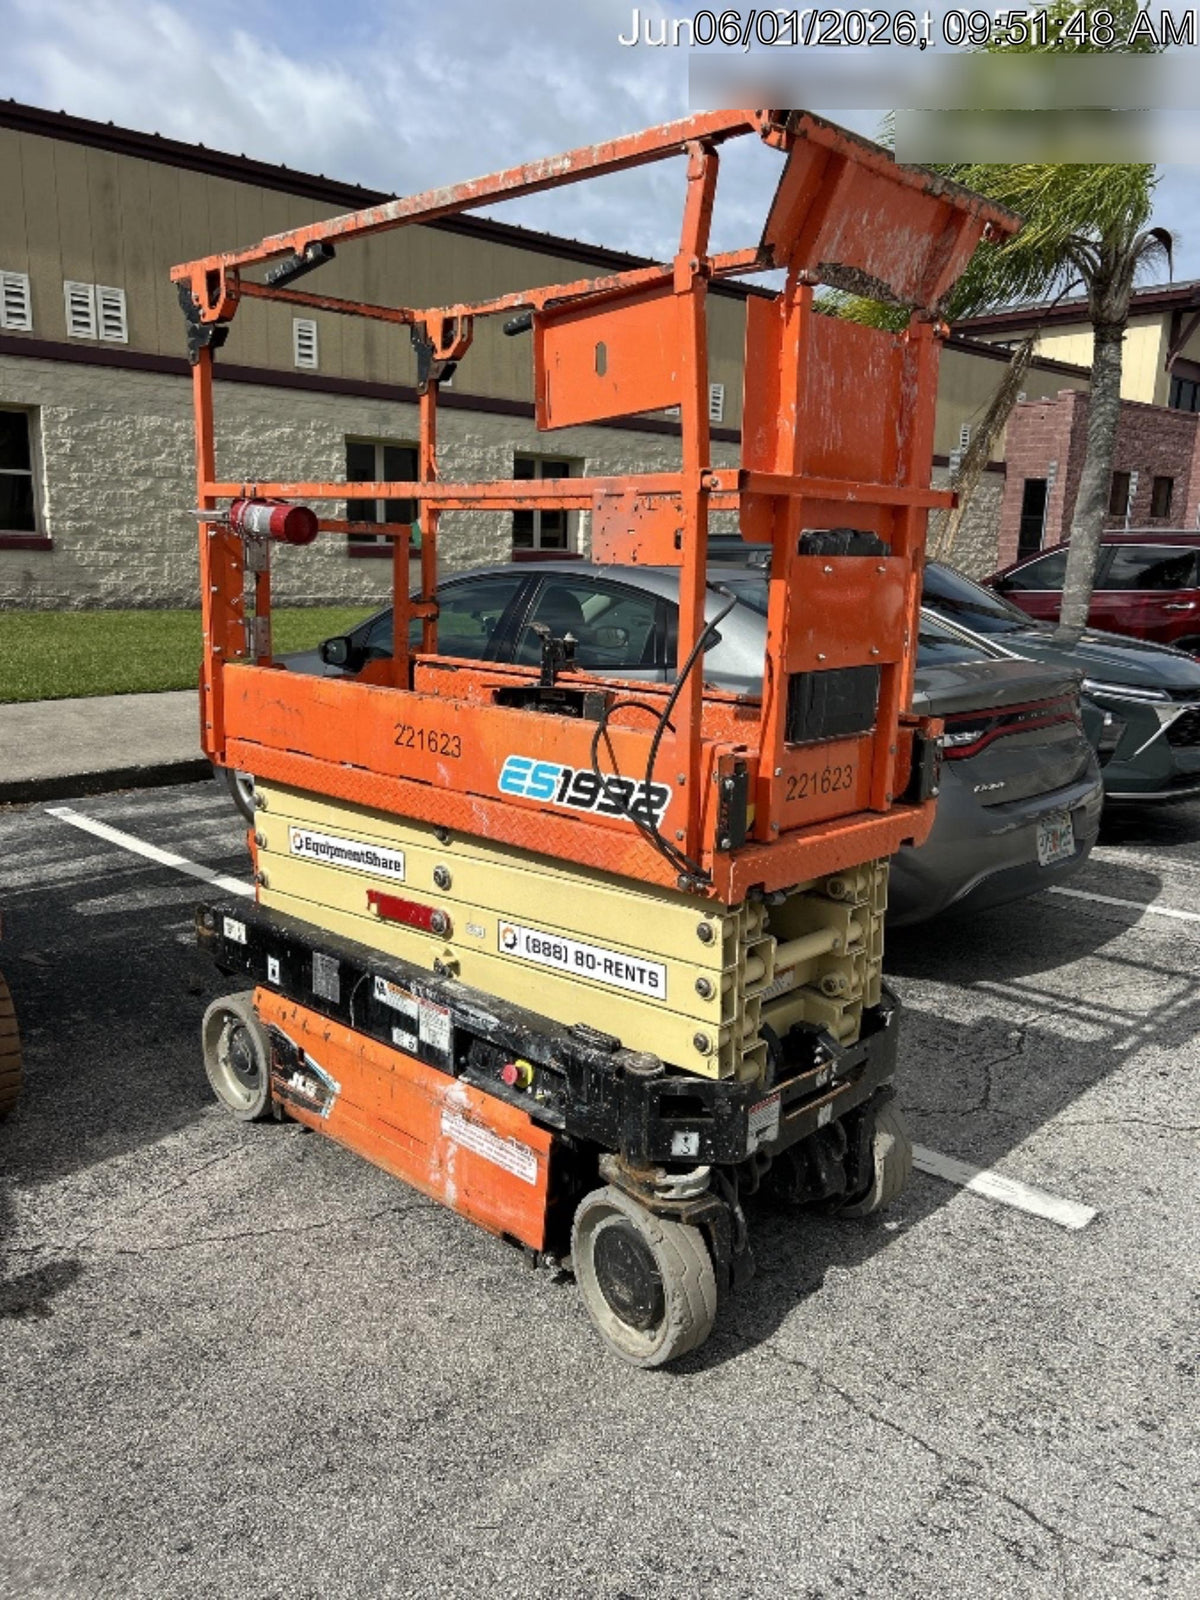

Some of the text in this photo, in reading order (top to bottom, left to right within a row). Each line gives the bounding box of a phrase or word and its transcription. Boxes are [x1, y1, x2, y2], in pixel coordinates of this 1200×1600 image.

[394, 723, 463, 759] 221623
[786, 764, 853, 802] 221623
[304, 837, 402, 872] EquipmentShare
[525, 934, 569, 965] (888)
